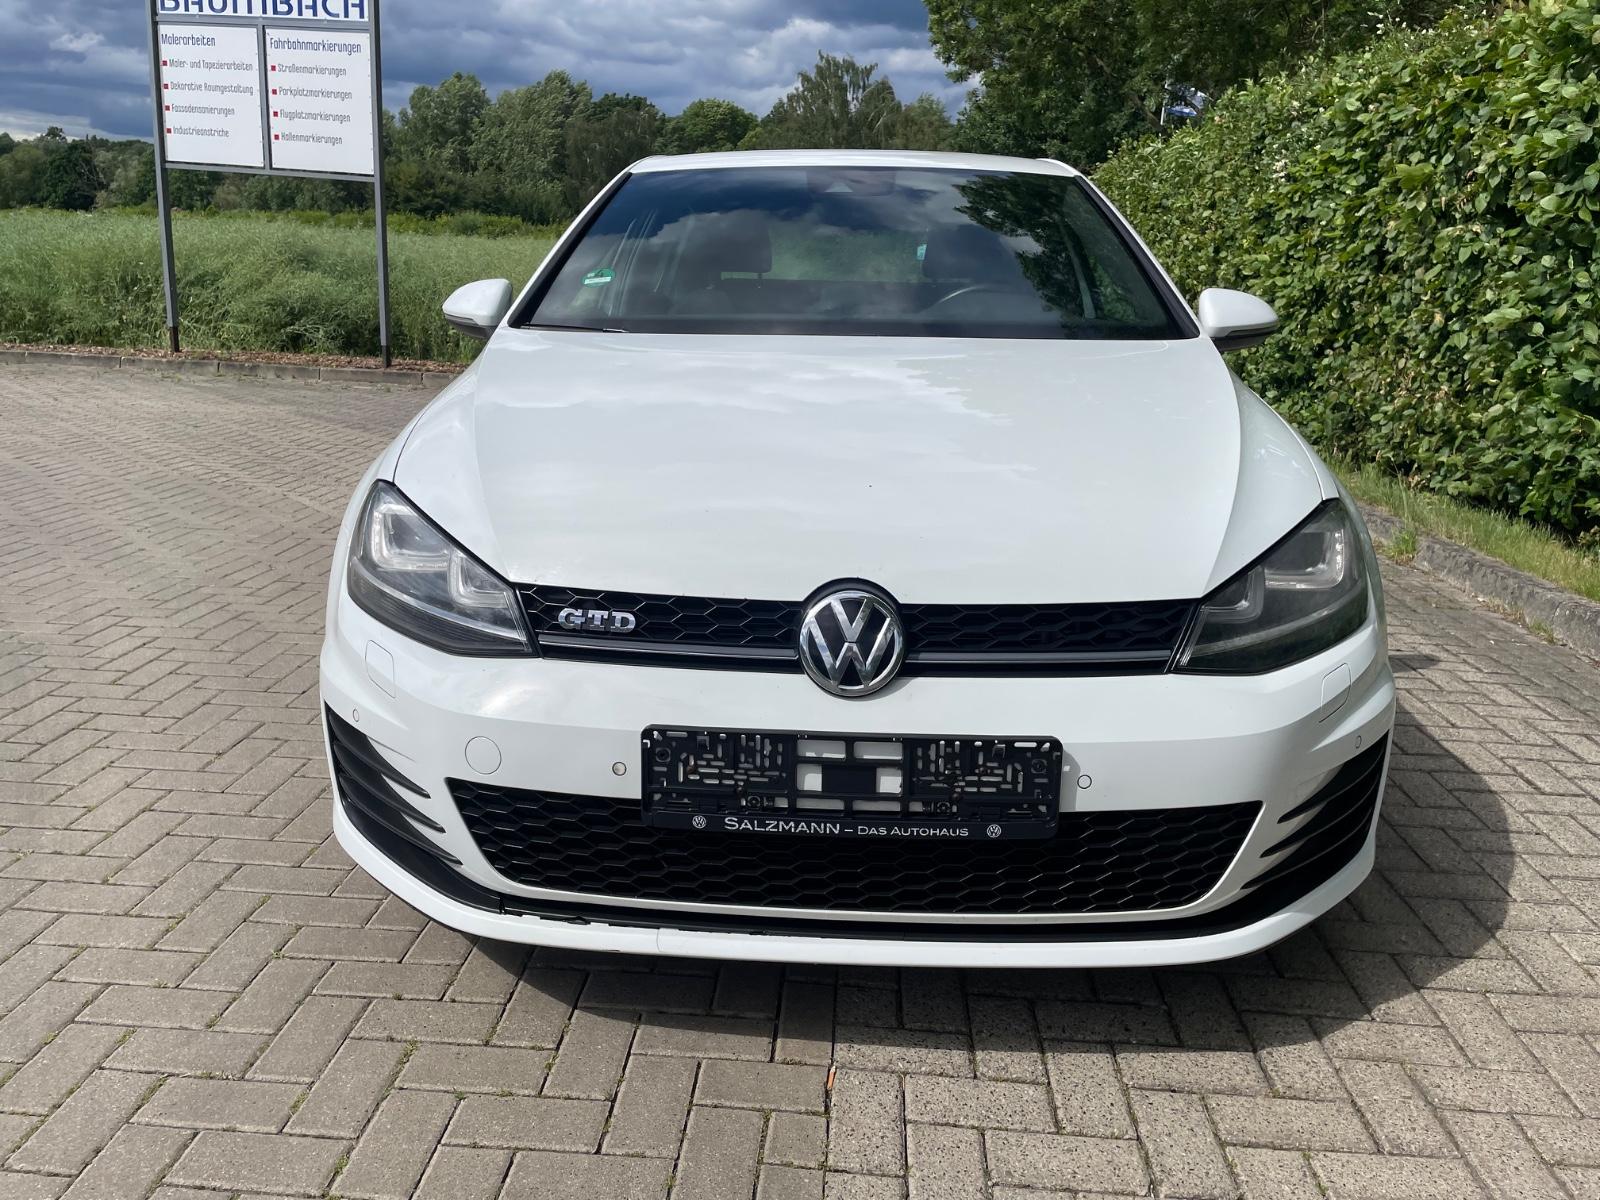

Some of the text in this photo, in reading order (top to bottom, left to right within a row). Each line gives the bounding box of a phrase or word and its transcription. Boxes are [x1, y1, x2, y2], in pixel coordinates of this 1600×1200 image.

[161, 33, 216, 47] Malerarbeiten
[269, 37, 362, 56] Fahrbahnmarkierungen
[169, 58, 253, 72] Maler- und Tapezierarbeiten
[277, 63, 347, 78] Straßenmarkierungen
[170, 81, 254, 96] Dekorative Raumgestaltung
[278, 86, 353, 101] Parkplatzmarkierungen
[171, 103, 235, 118] Fassadensanierungen
[280, 108, 351, 125] Flugplatzmarkierungen
[173, 125, 230, 138] Industrieanstriche
[281, 131, 343, 147] Hallenmarkierungen
[557, 607, 636, 634] GTD
[724, 816, 840, 835] SALZMANN
[857, 825, 887, 836] DAS
[890, 826, 969, 837] AUTOHAUS
